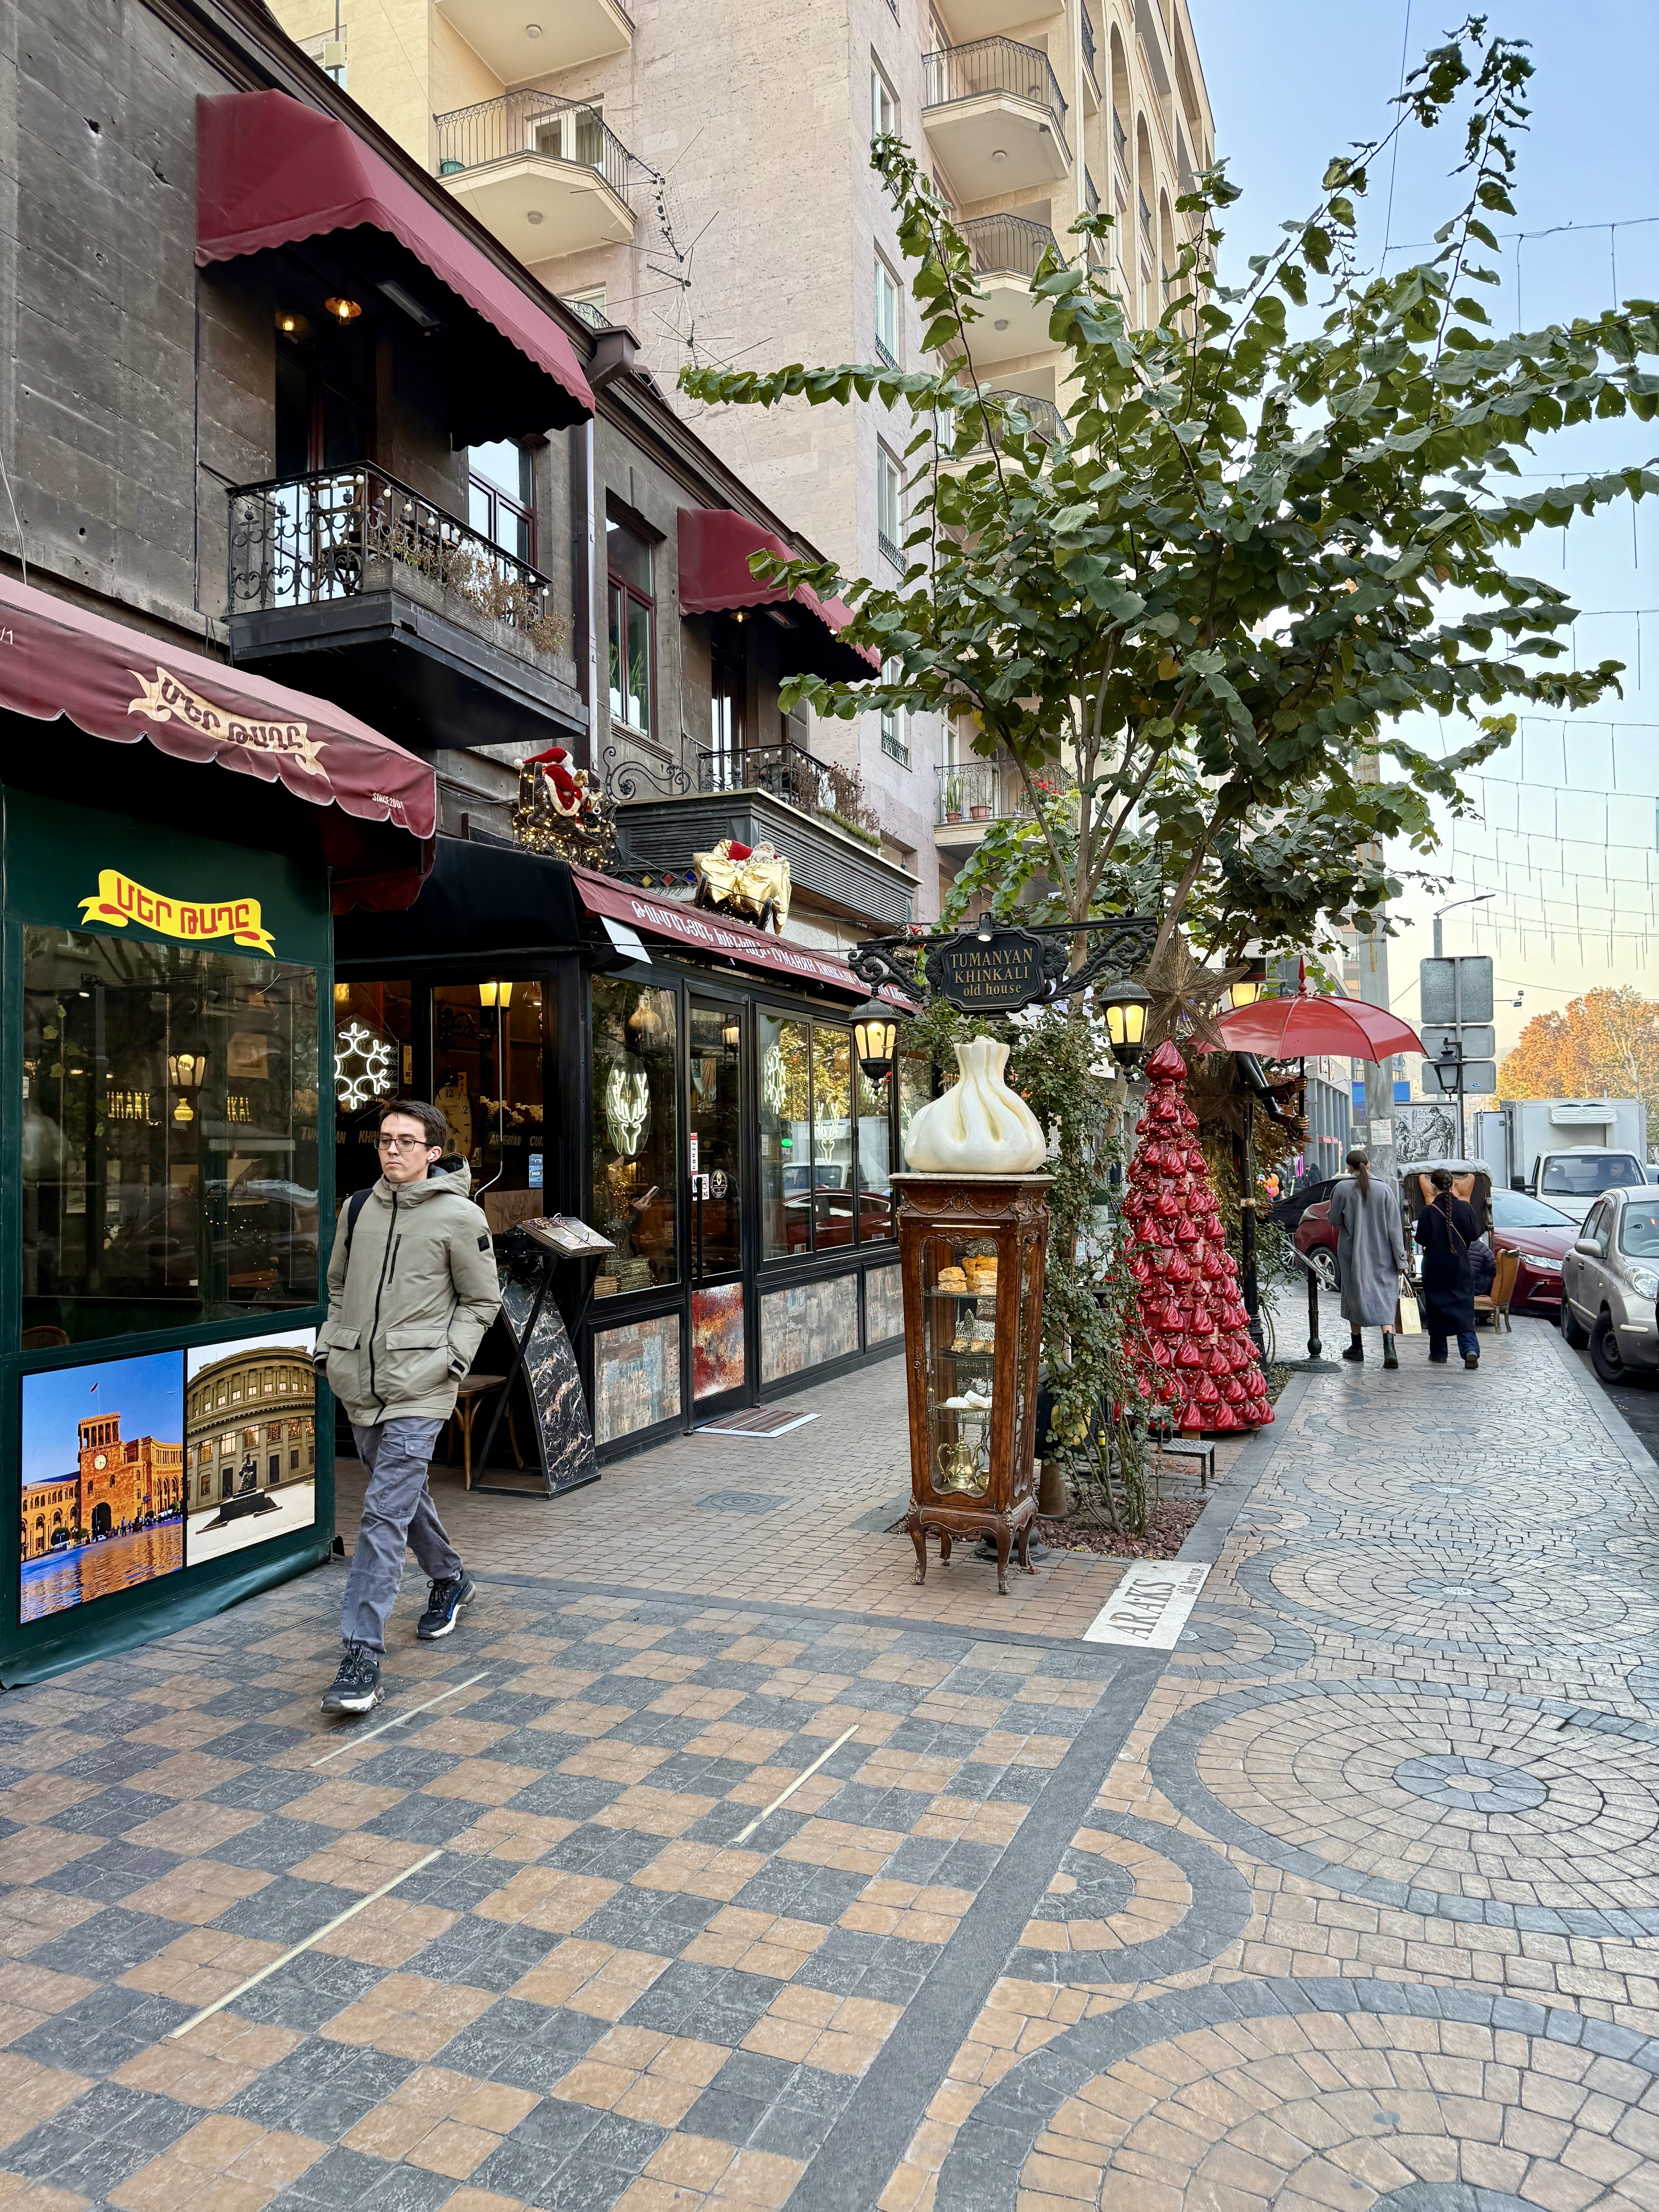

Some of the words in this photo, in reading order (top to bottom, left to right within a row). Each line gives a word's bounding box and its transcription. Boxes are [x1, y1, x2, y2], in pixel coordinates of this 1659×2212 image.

[950, 948, 1033, 968] TUMANYAN
[955, 967, 1029, 984] KHINKALI
[963, 984, 981, 997] old
[986, 983, 1022, 997] house
[1180, 1568, 1206, 1585] house
[1177, 1585, 1197, 1594] old
[1106, 1579, 1176, 1640] ARAKS
